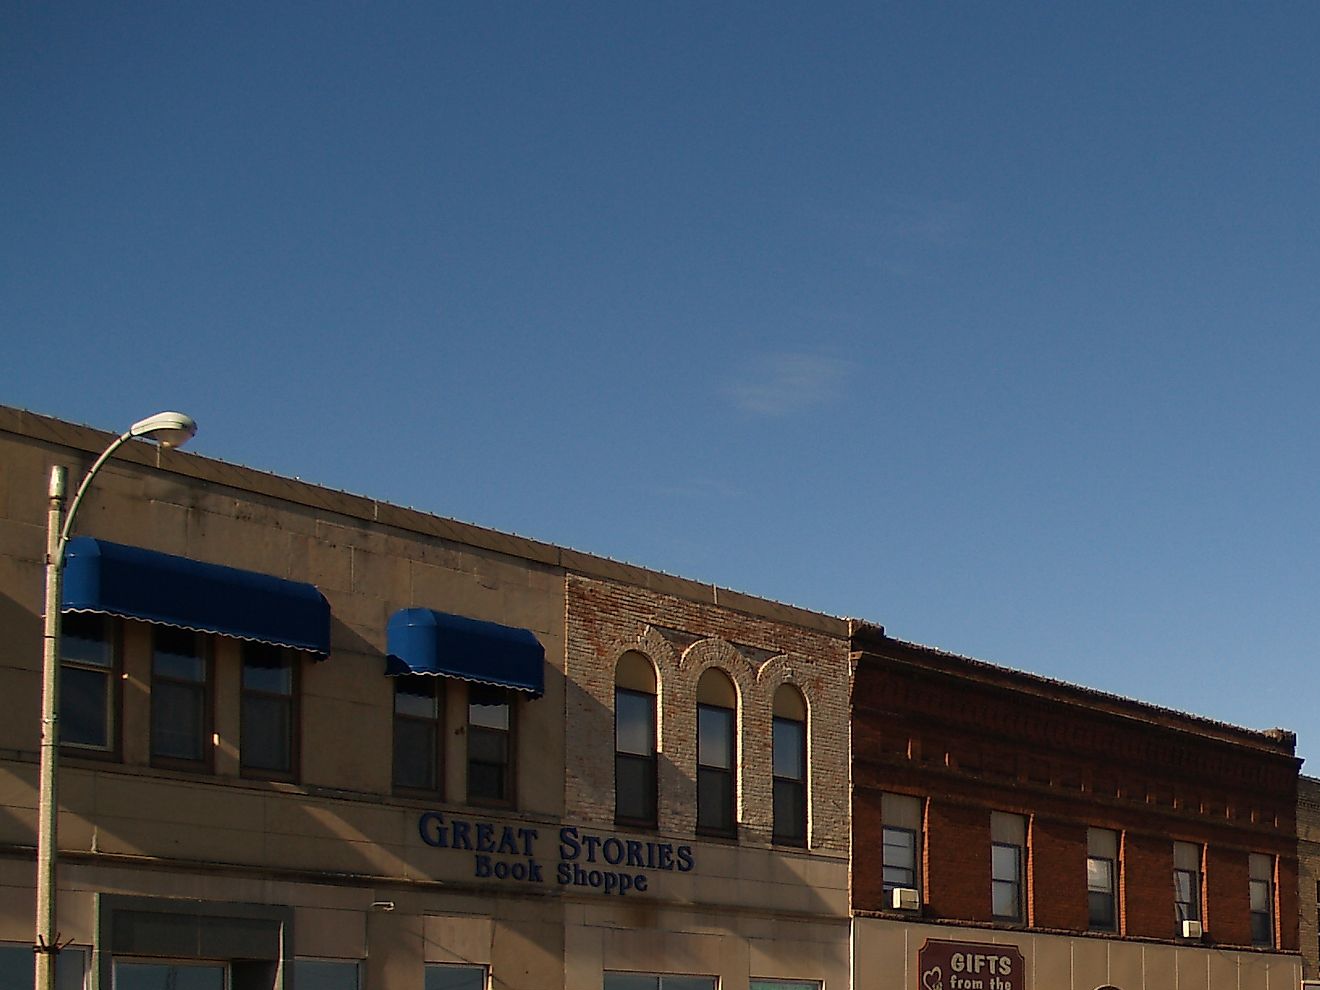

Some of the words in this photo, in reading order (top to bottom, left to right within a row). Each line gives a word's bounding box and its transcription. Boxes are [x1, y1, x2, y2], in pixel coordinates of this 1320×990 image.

[419, 811, 538, 856] GREAT
[559, 827, 695, 872] STORIES
[475, 854, 543, 882] Book
[557, 863, 648, 895] Shoppe
[950, 952, 1011, 975] GIFTS
[950, 974, 983, 990] from
[990, 977, 1011, 990] the
